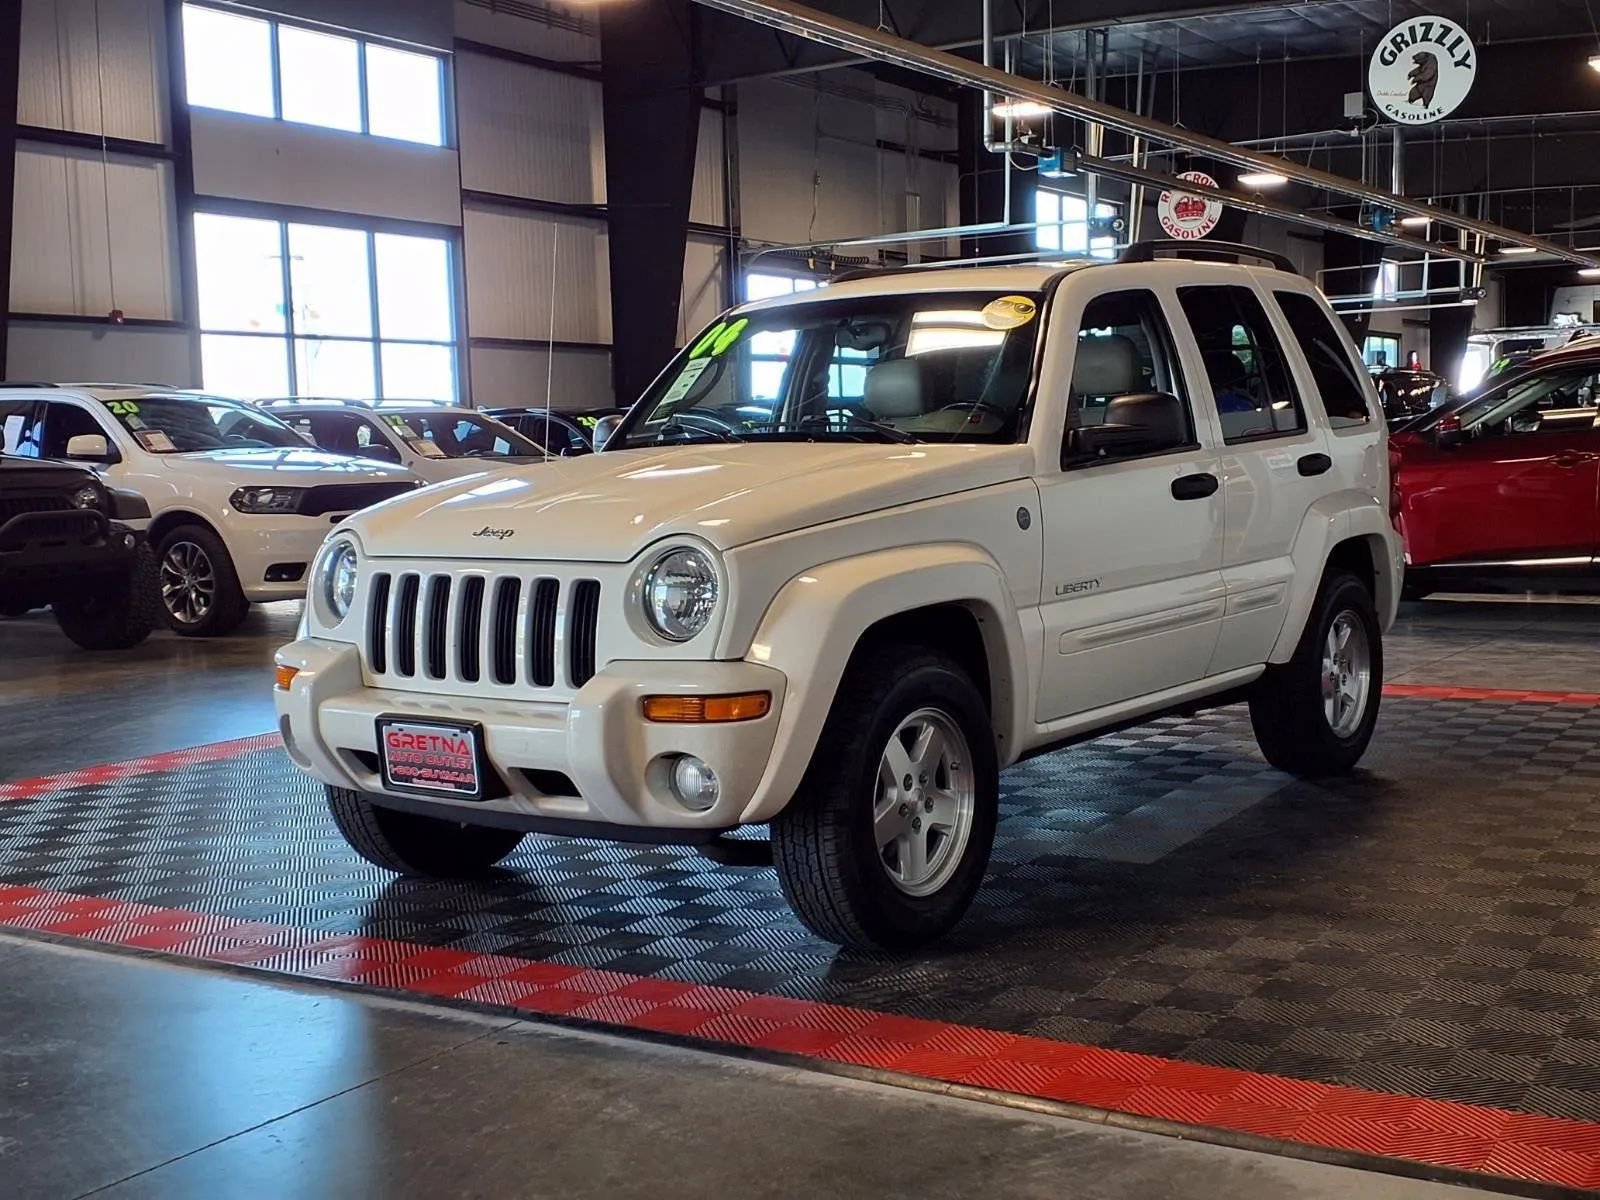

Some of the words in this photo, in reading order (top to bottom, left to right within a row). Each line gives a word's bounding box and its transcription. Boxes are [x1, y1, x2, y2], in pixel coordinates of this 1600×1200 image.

[1379, 21, 1472, 70] GRIZZLY
[1385, 103, 1445, 121] GASOLINE
[1184, 173, 1216, 187] CRO
[1161, 214, 1218, 239] GASOLINE
[106, 400, 140, 414] 20
[471, 526, 515, 540] Jeep
[1055, 578, 1102, 596] LIBERTY
[387, 732, 471, 756] GRETNA
[389, 751, 424, 764] AUTO
[426, 754, 474, 770] OUTLET
